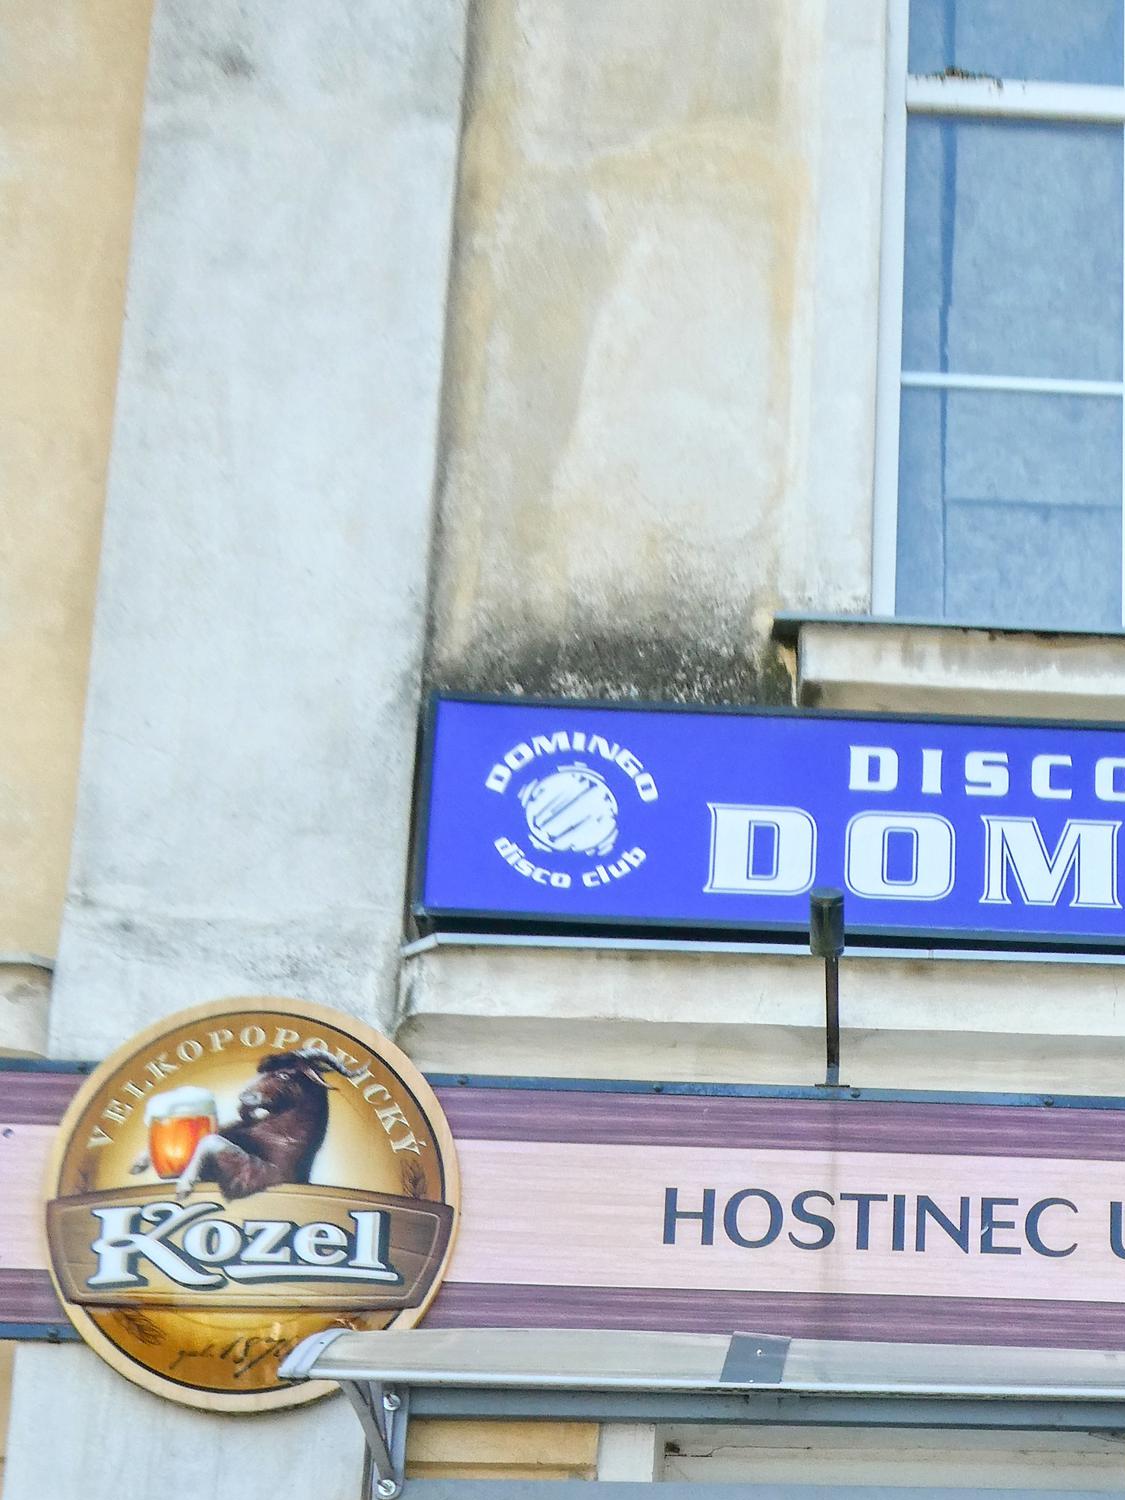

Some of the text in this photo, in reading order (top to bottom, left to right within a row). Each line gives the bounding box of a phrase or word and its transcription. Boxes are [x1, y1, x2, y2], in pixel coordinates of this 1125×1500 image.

[485, 730, 659, 802] DOMINGO
[493, 835, 648, 889] disco club
[86, 1200, 404, 1291] Kozel
[662, 1186, 1079, 1258] HOSTINEC
